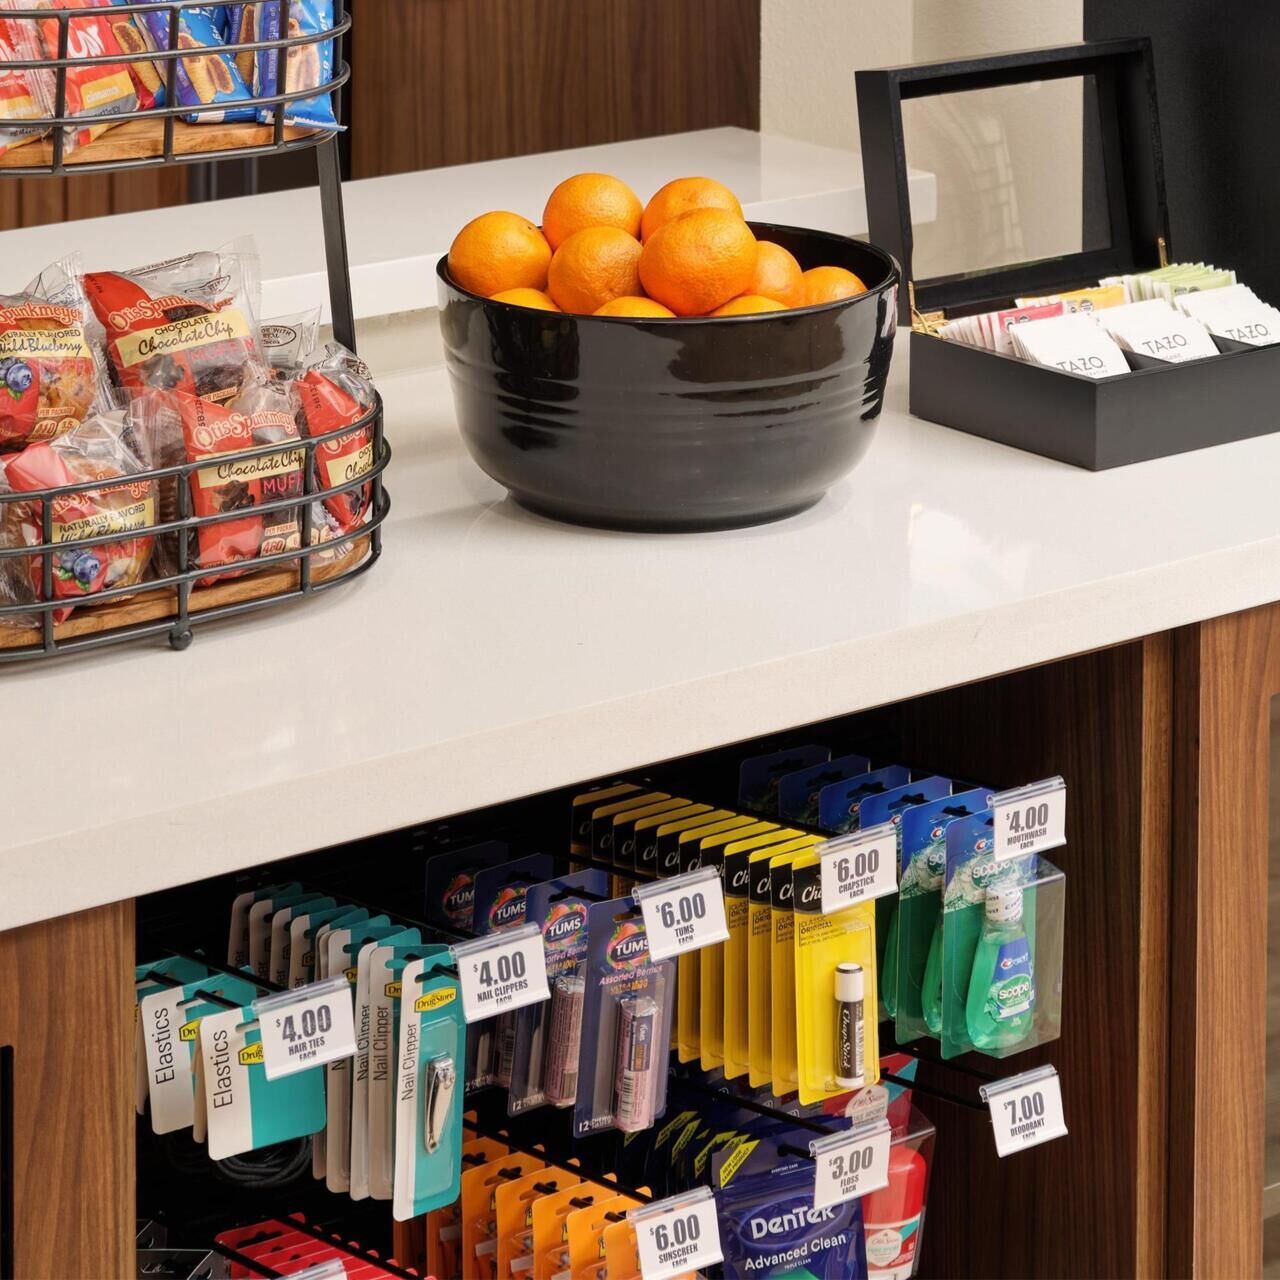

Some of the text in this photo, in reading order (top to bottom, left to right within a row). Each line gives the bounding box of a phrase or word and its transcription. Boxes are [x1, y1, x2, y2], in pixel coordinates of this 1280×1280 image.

[40, 329, 81, 339] FLAVORED
[154, 315, 210, 336] CHOCOLATE
[273, 327, 291, 336] WITH
[1225, 323, 1269, 342] TAZO
[29, 337, 83, 357] Blueberry
[138, 319, 234, 356] Chocolate Chip
[1141, 333, 1187, 354] TAZO
[1056, 356, 1104, 372] TAZO
[217, 454, 280, 480] Chocolate
[263, 474, 304, 494] MUFF
[59, 515, 108, 533] NATURALLY
[1006, 803, 1048, 833] $4.00
[1007, 827, 1047, 846] MOUTHWASH
[1020, 840, 1034, 849] EACH
[833, 849, 879, 883] $6.00
[838, 875, 875, 894] CHAPSTICK
[849, 889, 865, 899] EACH
[450, 890, 475, 904] TUM
[496, 902, 526, 920] TUMS
[656, 892, 706, 929] $6.00
[549, 919, 581, 937] TUMS
[675, 924, 695, 937] TUMS
[473, 951, 526, 988] $4.00
[477, 979, 528, 1003] NAIL CLIPPERS
[999, 982, 1029, 1000] scope
[276, 1005, 331, 1042] $4.00
[152, 1007, 175, 1084] Elastics
[289, 1037, 325, 1056] HAIR TIES
[373, 1005, 389, 1081] Nail Clipper
[210, 1029, 233, 1108] Elastics
[401, 1023, 417, 1101] Nail Clipper
[1003, 1091, 1044, 1125] $7.00
[579, 1122, 589, 1133] 12
[1011, 1118, 1045, 1136] DEODORANT
[828, 1146, 873, 1180] $3.00
[840, 1174, 859, 1187] FLOSS
[842, 1185, 857, 1195] EACH
[751, 1205, 835, 1240] DenTek
[650, 1214, 701, 1252] $6.00
[658, 1242, 698, 1265] SUNSCREEN
[744, 1233, 846, 1271] Advanced Clean
[798, 1258, 812, 1267] CLEAN
